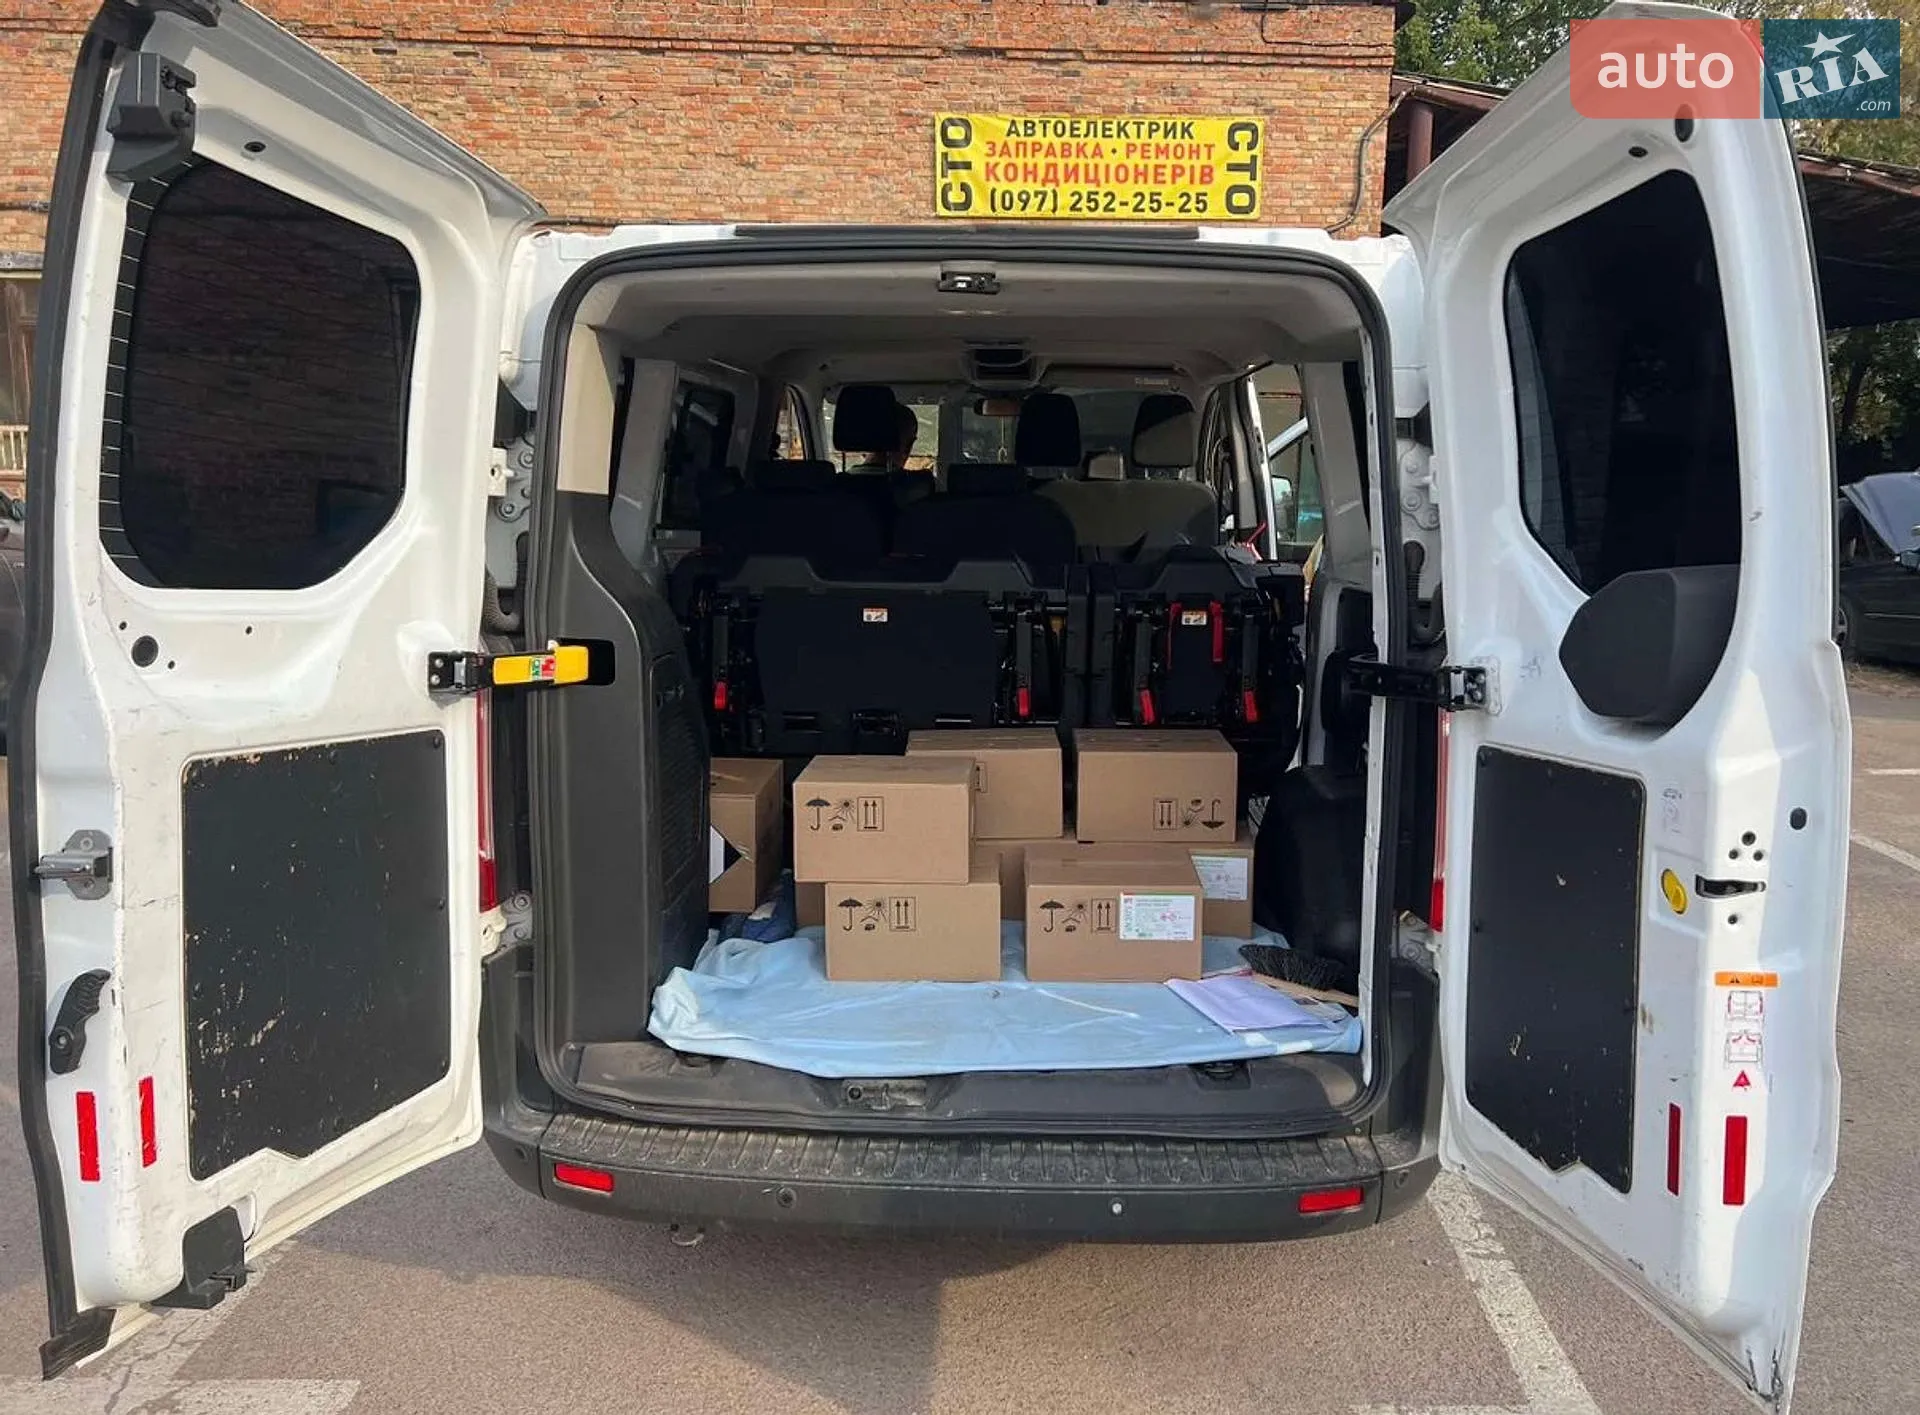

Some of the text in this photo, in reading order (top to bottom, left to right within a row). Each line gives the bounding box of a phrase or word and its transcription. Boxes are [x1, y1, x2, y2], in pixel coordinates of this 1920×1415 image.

[1005, 119, 1195, 140] АВТОЕЛЕКТРИК
[984, 141, 1216, 160] ЗАПРАВКА РЕМОНТ
[940, 117, 973, 212] СТО
[984, 162, 1215, 188] КОНДИЦІОНЕРІВ
[1225, 122, 1259, 215] СТО
[989, 188, 1209, 213] (097) 252-25-25
